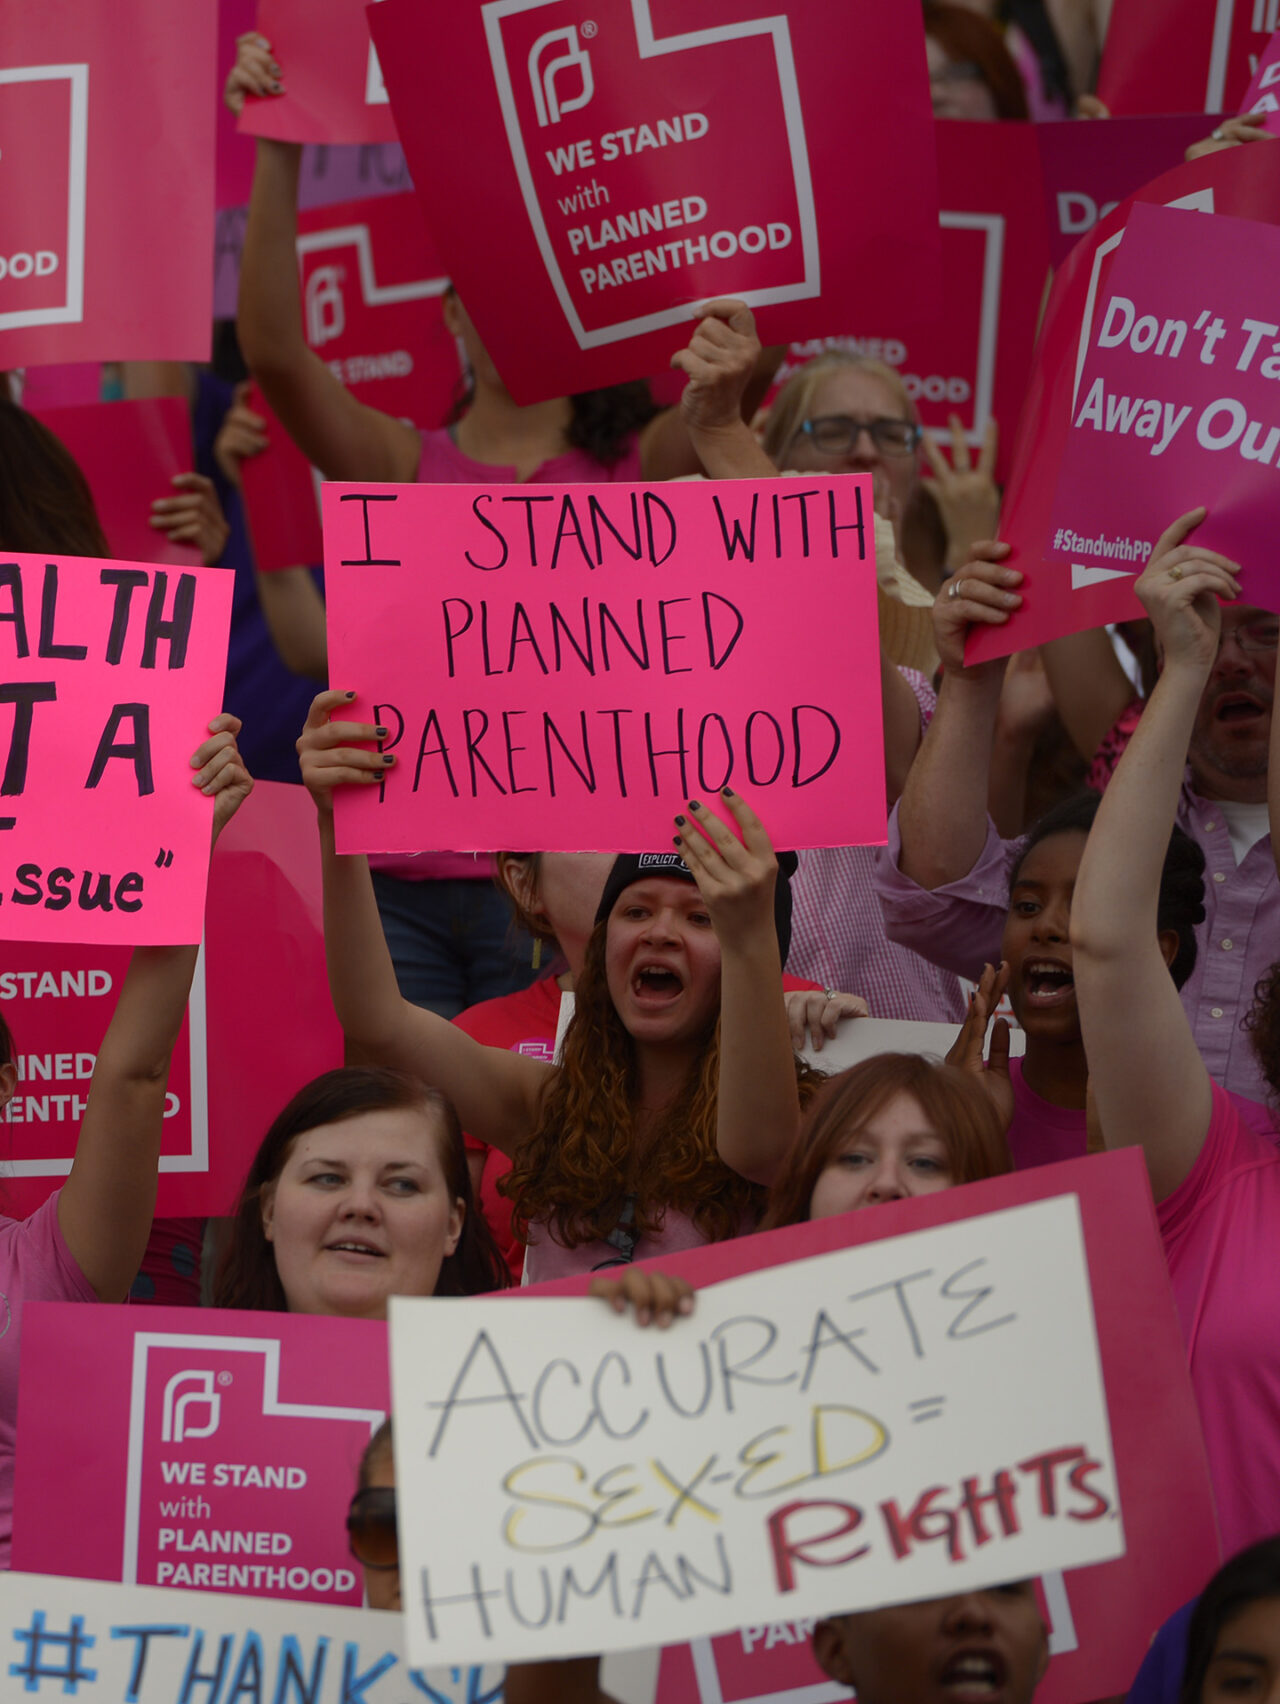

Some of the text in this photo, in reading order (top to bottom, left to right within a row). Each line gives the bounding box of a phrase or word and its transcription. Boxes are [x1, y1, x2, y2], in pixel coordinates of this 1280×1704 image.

[546, 113, 709, 176] WE STAND
[557, 180, 610, 216] with
[567, 196, 708, 256] PLANNED
[579, 222, 792, 294] PARENTHOOD
[1097, 296, 1227, 365] Don't
[345, 350, 414, 384] STAND
[1075, 377, 1193, 456] Away
[340, 486, 866, 571] I STAND WITH
[1053, 528, 1153, 563] #StandwithPP
[442, 591, 744, 677] PLANNED
[84, 702, 155, 797] A
[373, 704, 841, 803] PARENTHOOD
[642, 854, 678, 865] EXPLICIT
[427, 1258, 1017, 1459] ACCURATE
[159, 1496, 211, 1519] with
[162, 1461, 307, 1490] WE STAND
[502, 1404, 892, 1554] SEX-ED
[158, 1528, 292, 1555] PLANNED
[156, 1562, 355, 1593] PARENTHOOD
[419, 1532, 734, 1642] HUMAN
